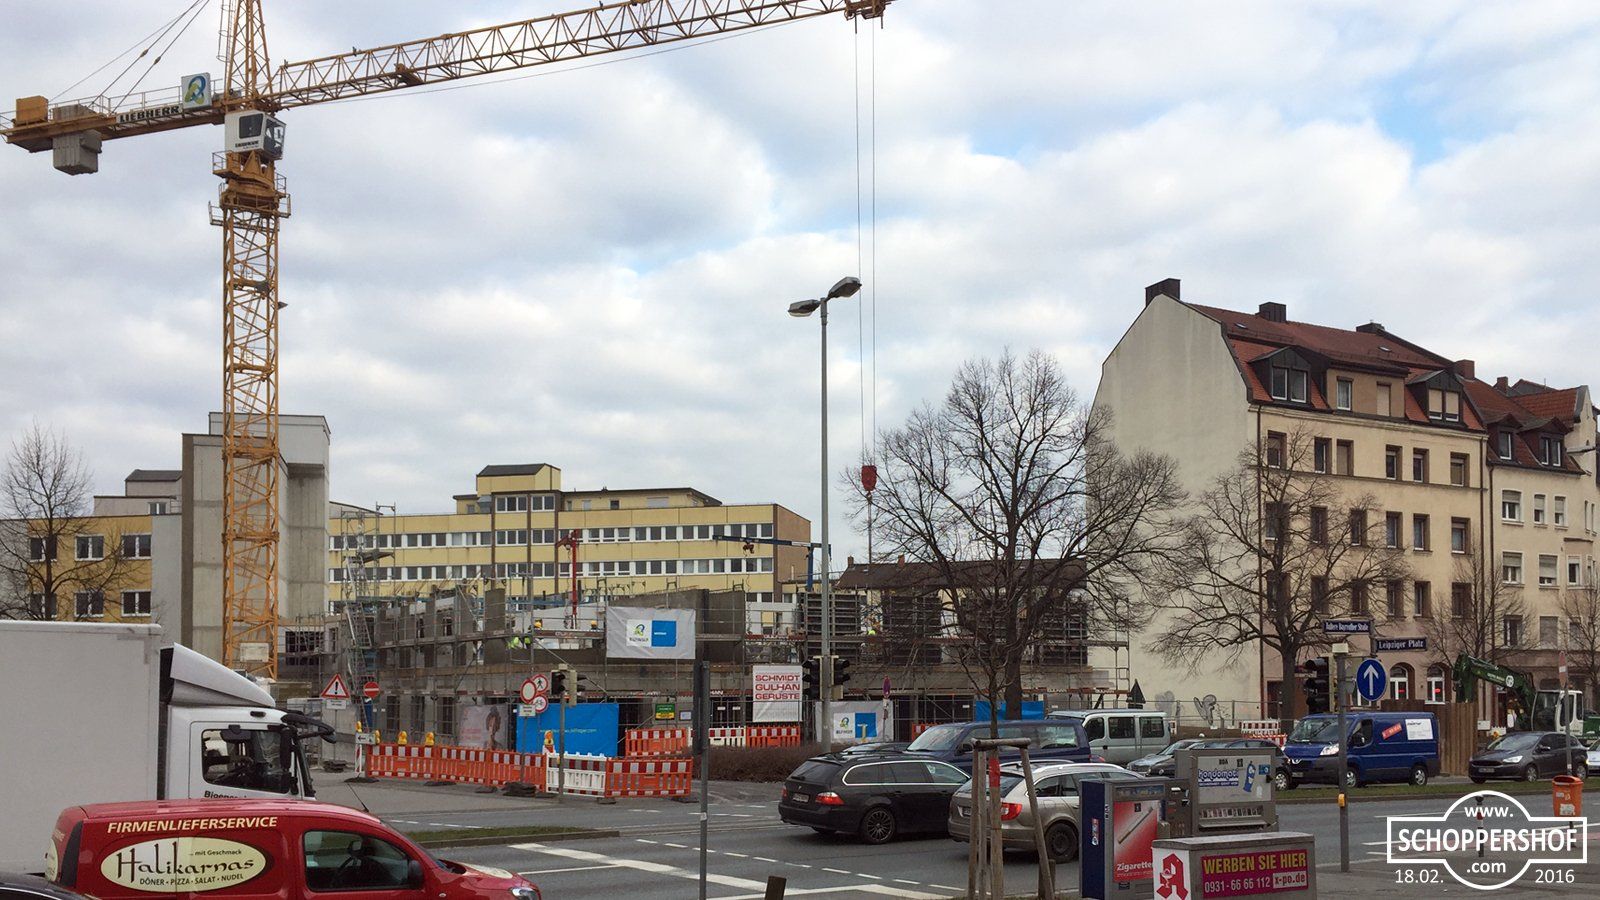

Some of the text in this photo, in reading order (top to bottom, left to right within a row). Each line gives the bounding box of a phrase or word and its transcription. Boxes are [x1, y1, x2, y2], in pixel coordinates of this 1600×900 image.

[120, 105, 180, 123] LIEBHERR
[1379, 639, 1424, 650] Leipziger Platz
[755, 674, 800, 682] SCHMIDT
[107, 817, 278, 834] FIRMENLIEFERSERVICE
[116, 841, 255, 883] Halikarnas
[1117, 861, 1153, 873] Zigarette
[1203, 852, 1306, 875] WERBEN SIE HIER
[140, 873, 244, 886] DÖNER PIZZA SALAT NUDEL
[1243, 878, 1254, 889] 66
[1256, 876, 1270, 888] 112
[1274, 873, 1305, 887] x-po.de
